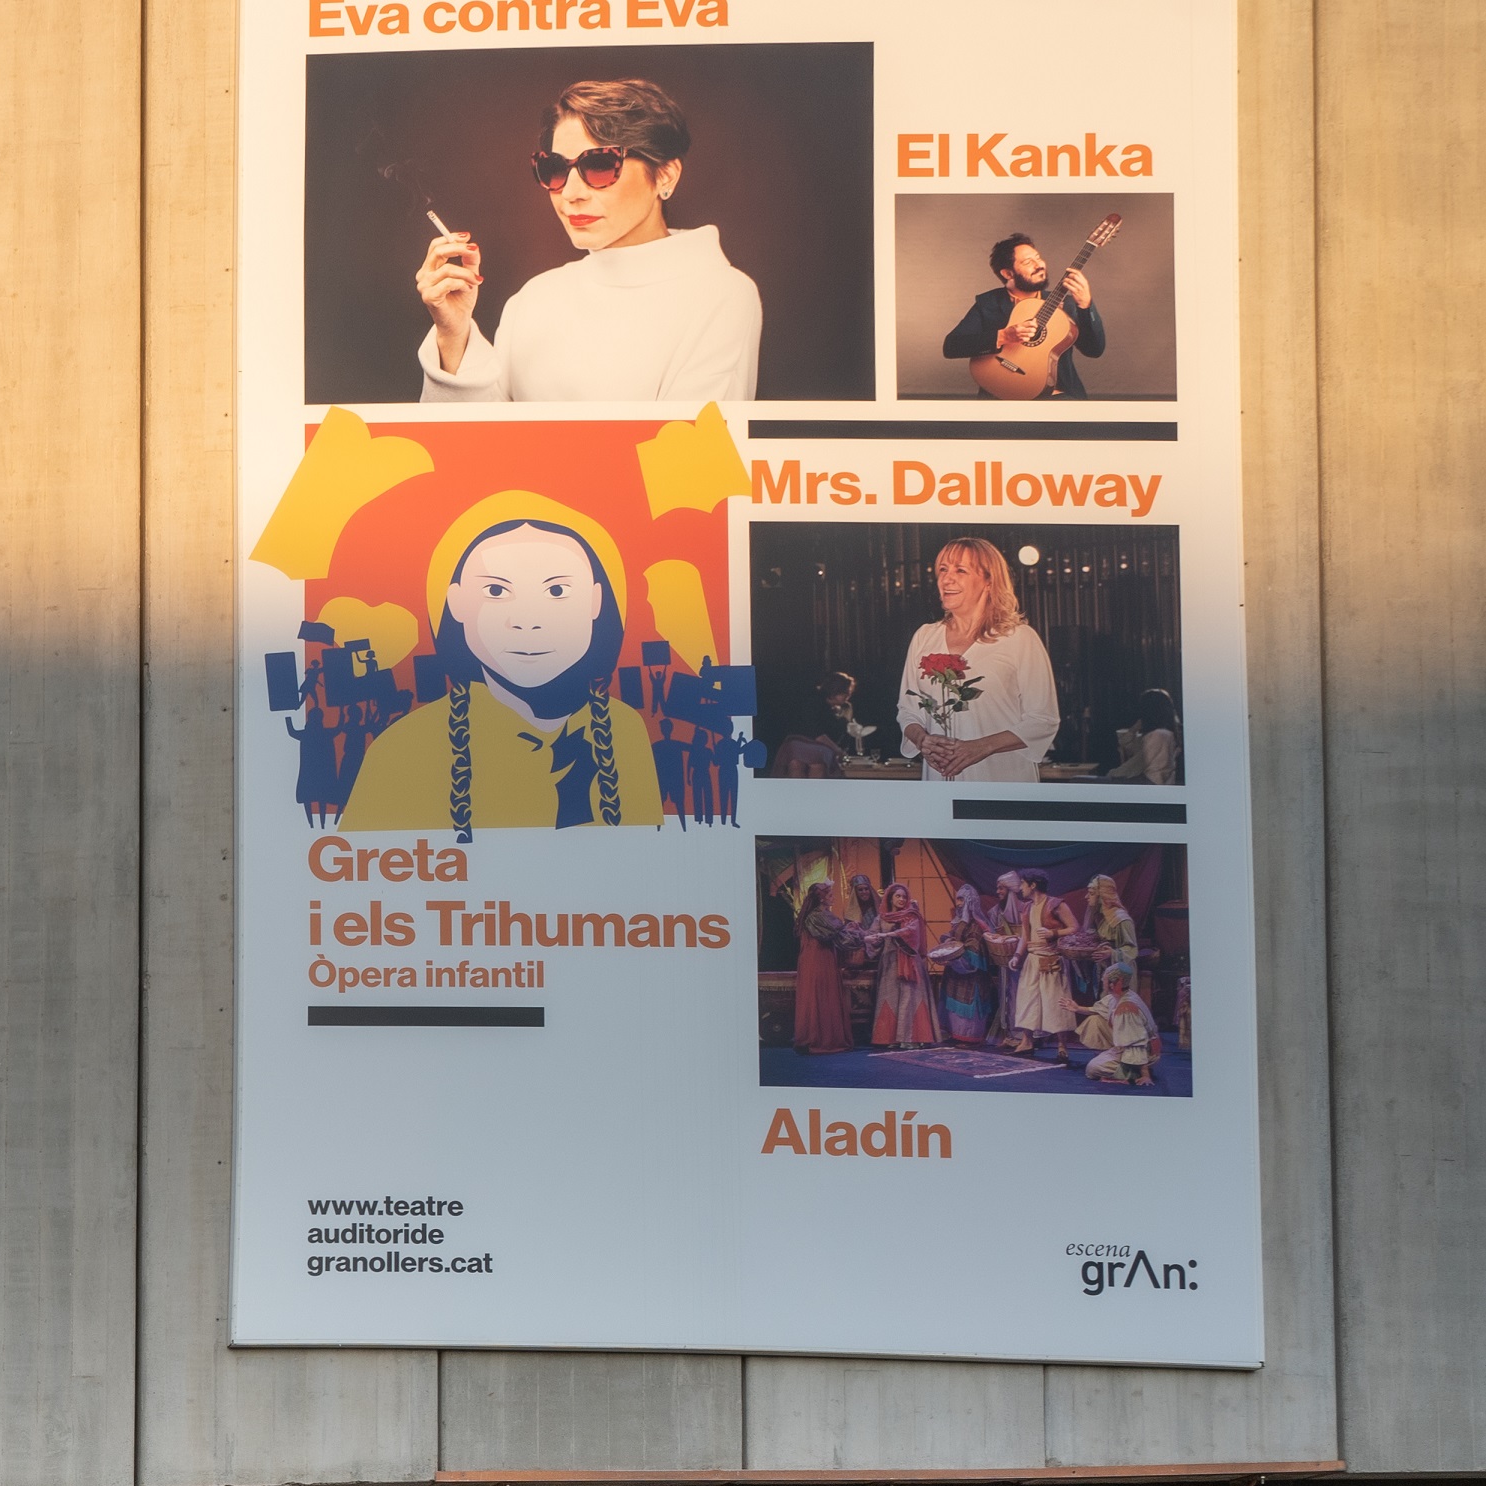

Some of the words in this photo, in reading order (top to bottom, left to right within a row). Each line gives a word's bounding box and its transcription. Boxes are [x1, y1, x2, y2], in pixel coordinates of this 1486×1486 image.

[308, 0, 411, 38] Eva
[424, 0, 612, 32] contra
[625, 0, 729, 27] Eva
[896, 134, 953, 178] El
[965, 133, 1154, 178] Kanka
[750, 461, 878, 507] Mrs.
[892, 463, 1161, 518] Dalloway
[307, 836, 468, 883] Greta
[309, 902, 321, 945] i
[332, 902, 415, 946] els
[426, 899, 731, 949] Trihumans
[307, 953, 418, 995] Òpera
[425, 960, 546, 989] infantil
[761, 1109, 953, 1160] Aladín
[307, 1195, 464, 1218] www.teatre
[307, 1222, 445, 1246] auditoride
[1065, 1242, 1132, 1258] escena
[306, 1251, 494, 1278] granollers.cat
